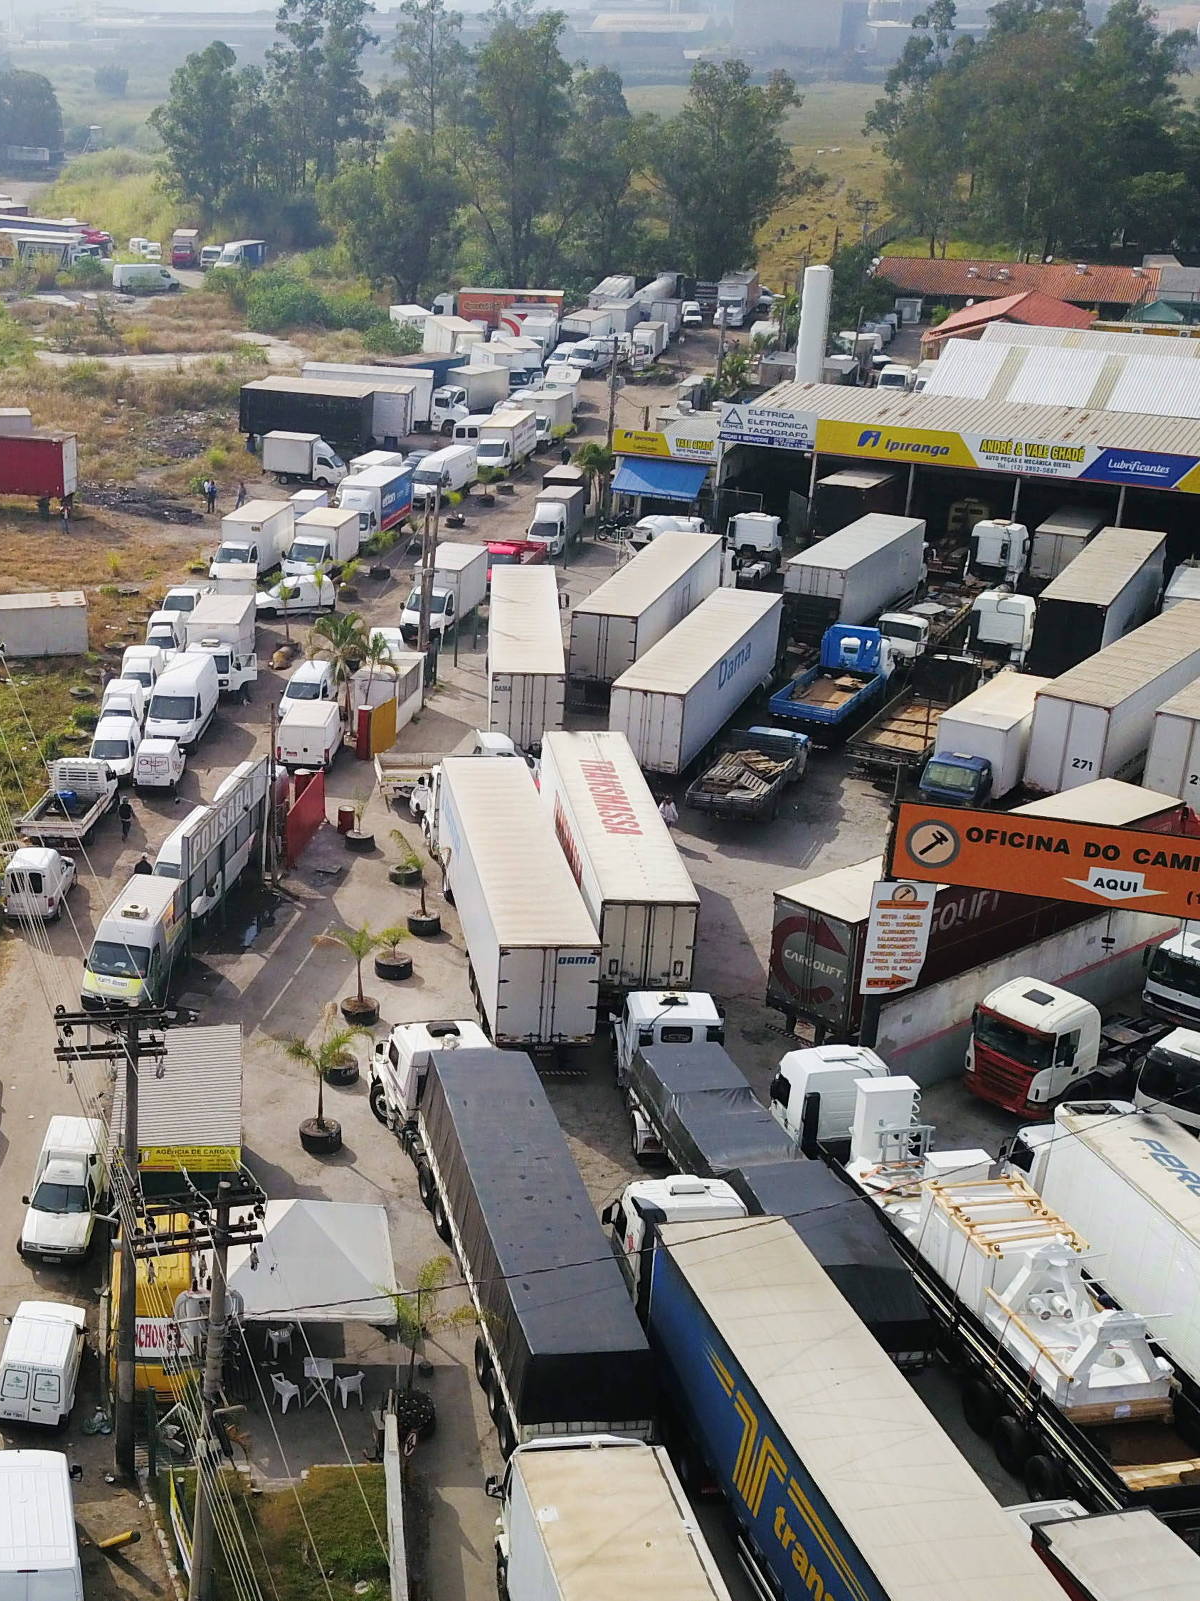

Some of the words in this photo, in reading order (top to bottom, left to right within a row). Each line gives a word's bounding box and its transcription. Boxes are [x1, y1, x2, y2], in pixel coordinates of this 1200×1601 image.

[748, 408, 795, 420] ELÉTRICA
[885, 439, 950, 457] ipiranga
[979, 438, 1013, 455] ANDRÉ
[1015, 442, 1023, 456] &
[1025, 443, 1049, 458] VALE
[1108, 458, 1170, 474] Lubrificantes
[1071, 758, 1093, 771] 271
[966, 826, 1070, 855] OFICINA
[1083, 841, 1120, 861] DO
[1093, 877, 1138, 893] AQUI
[785, 949, 844, 979] CARGOLIFT
